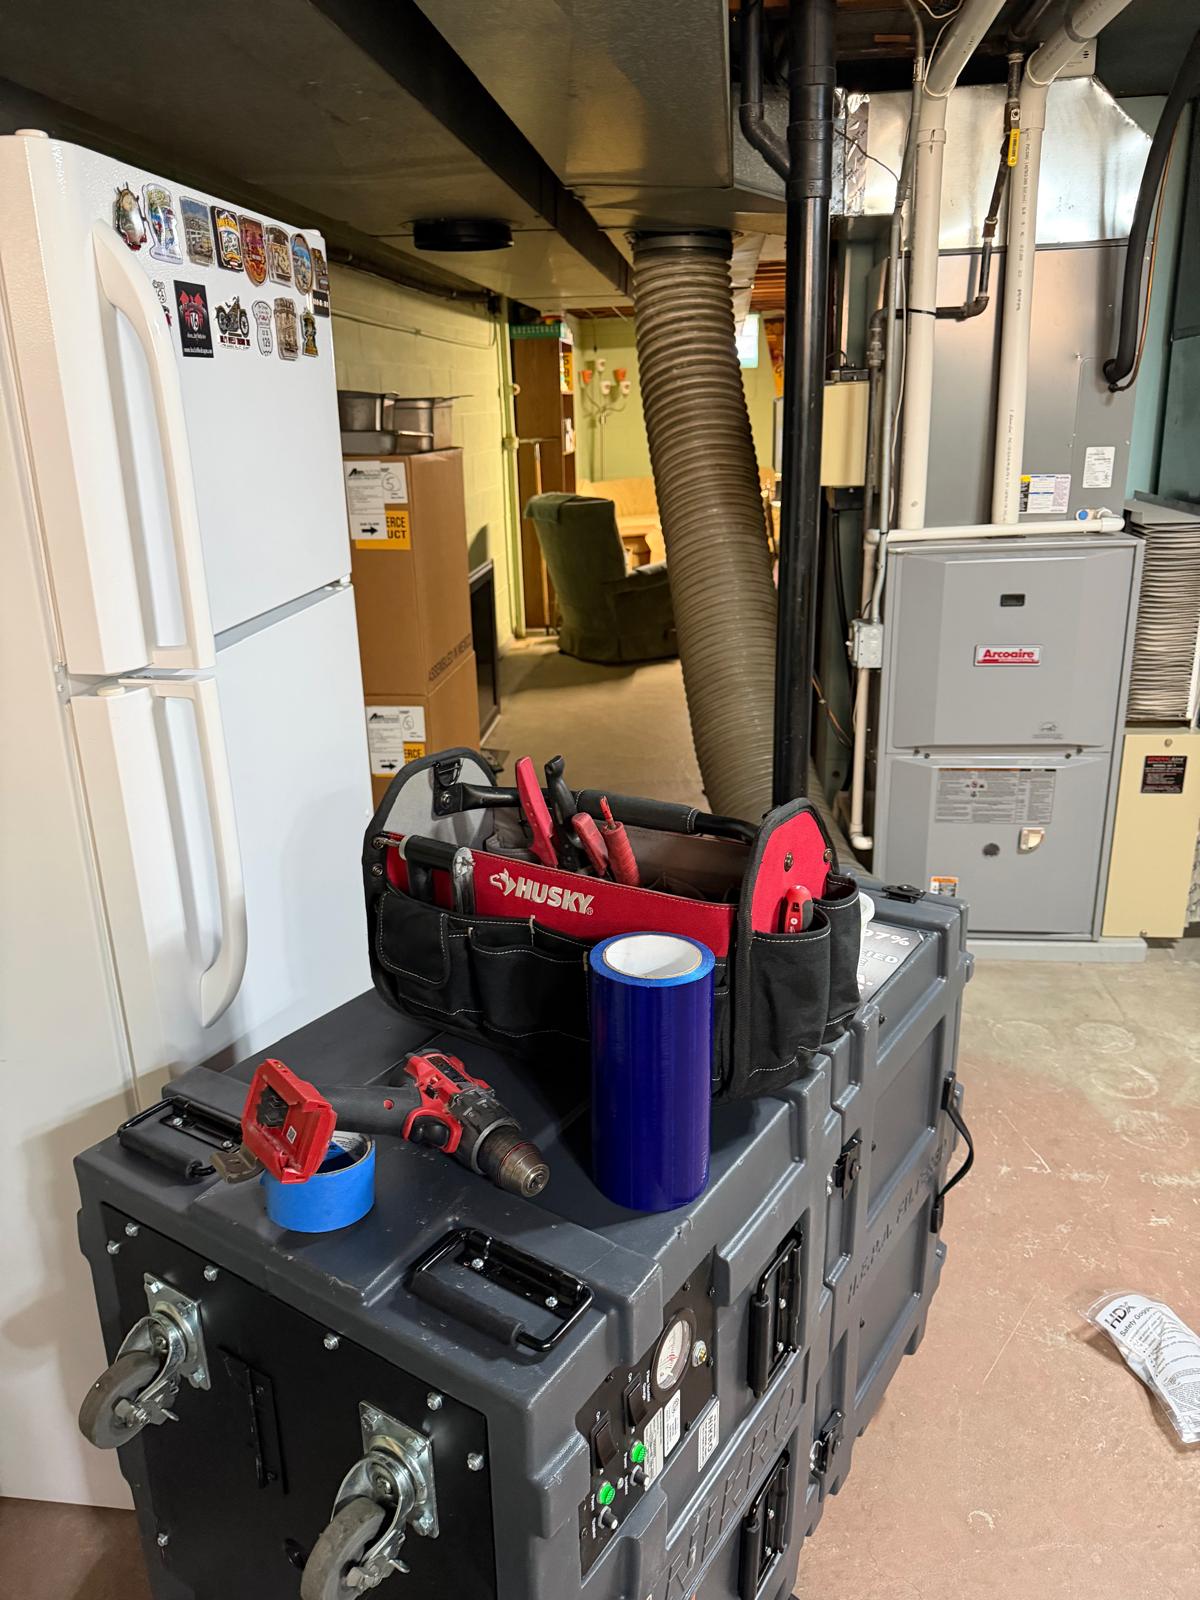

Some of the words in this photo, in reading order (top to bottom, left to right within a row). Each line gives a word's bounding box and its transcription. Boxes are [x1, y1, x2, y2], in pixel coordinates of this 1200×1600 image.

[984, 649, 1034, 658] Arcoaire
[514, 876, 594, 915] HUSKY
[1104, 1302, 1136, 1330] HDX
[1120, 1319, 1136, 1337] Safety
